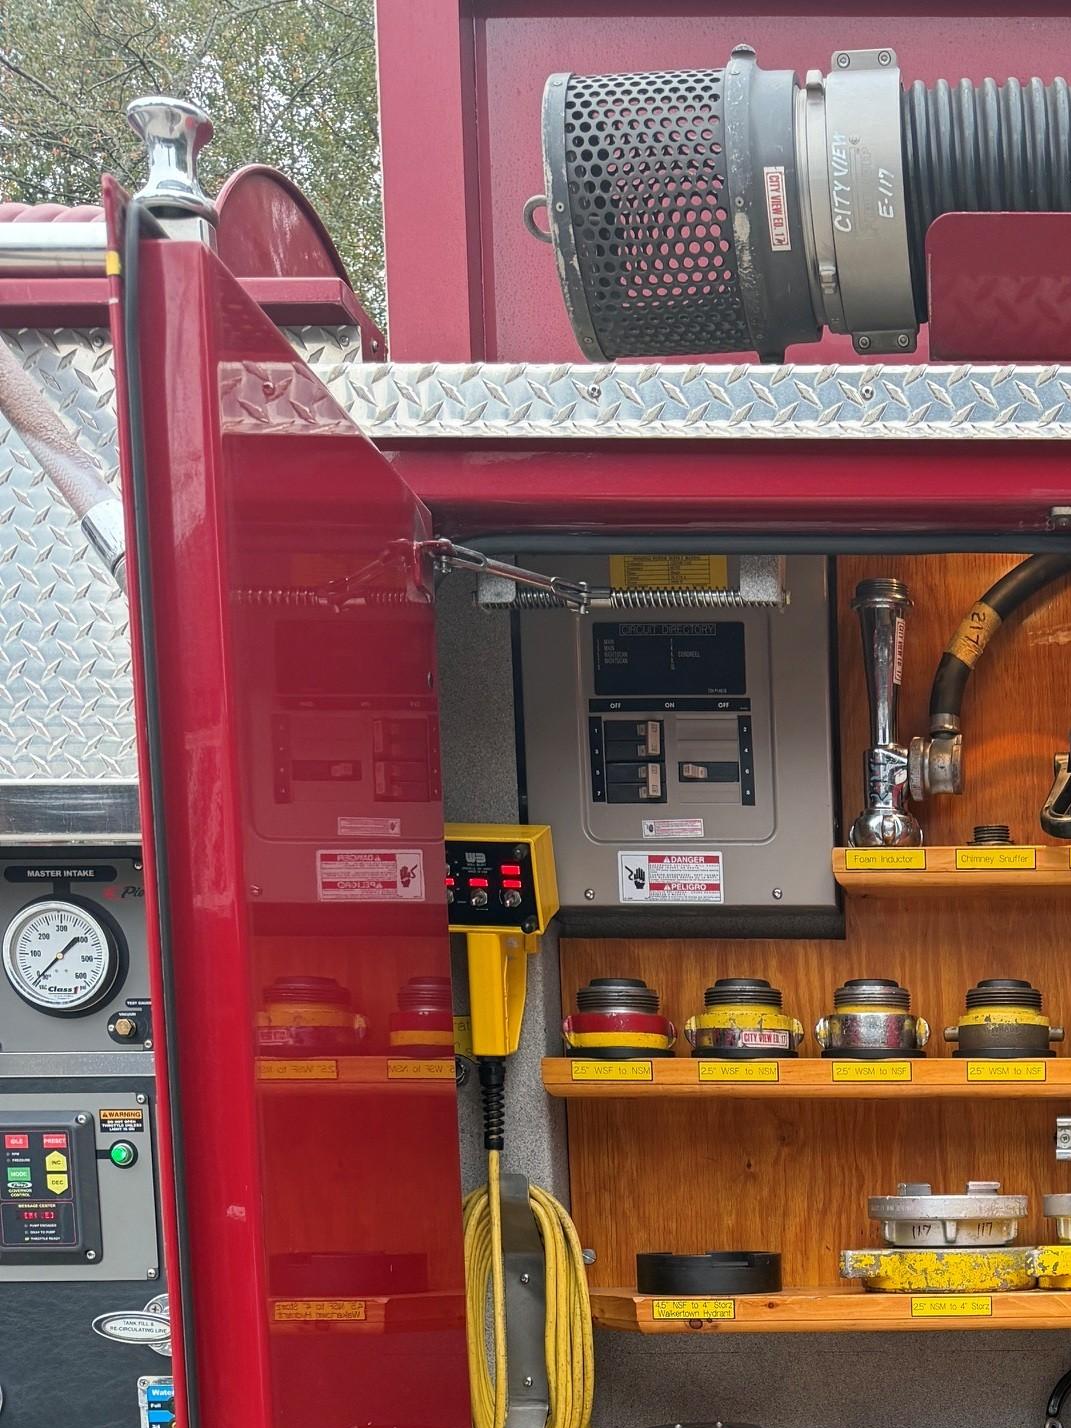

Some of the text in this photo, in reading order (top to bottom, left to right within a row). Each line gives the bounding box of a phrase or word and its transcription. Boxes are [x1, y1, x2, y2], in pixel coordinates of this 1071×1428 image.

[768, 174, 782, 193] CITY
[831, 131, 852, 233] CITY VIEW
[878, 168, 894, 219] E-117
[770, 195, 784, 216] VIEW
[621, 625, 714, 635] CIRCUIT DIRECTORY
[853, 855, 914, 863] Foam Inductor
[960, 854, 1030, 865] Chimney Snuffer
[27, 869, 94, 878] MASTER INTAKE
[38, 933, 50, 941] 200
[75, 972, 87, 980] 600
[743, 1033, 772, 1043] CITY VIEW
[594, 1066, 613, 1075] WSF
[619, 1066, 627, 1075] to
[632, 1066, 651, 1075] NSM
[721, 1066, 740, 1075] WSF
[745, 1066, 753, 1075] to
[758, 1066, 776, 1075] NSM
[855, 1066, 876, 1075] WSM
[880, 1066, 887, 1075] to
[892, 1066, 907, 1075] NSF
[989, 1066, 1009, 1075] WSM
[1014, 1066, 1022, 1075] to
[1026, 1066, 1043, 1075] NSF
[912, 1222, 993, 1239] 117 117
[930, 1302, 947, 1310] NSM
[949, 1302, 957, 1310] to
[971, 1302, 990, 1310] Storz
[703, 1310, 731, 1318] Hydrant
